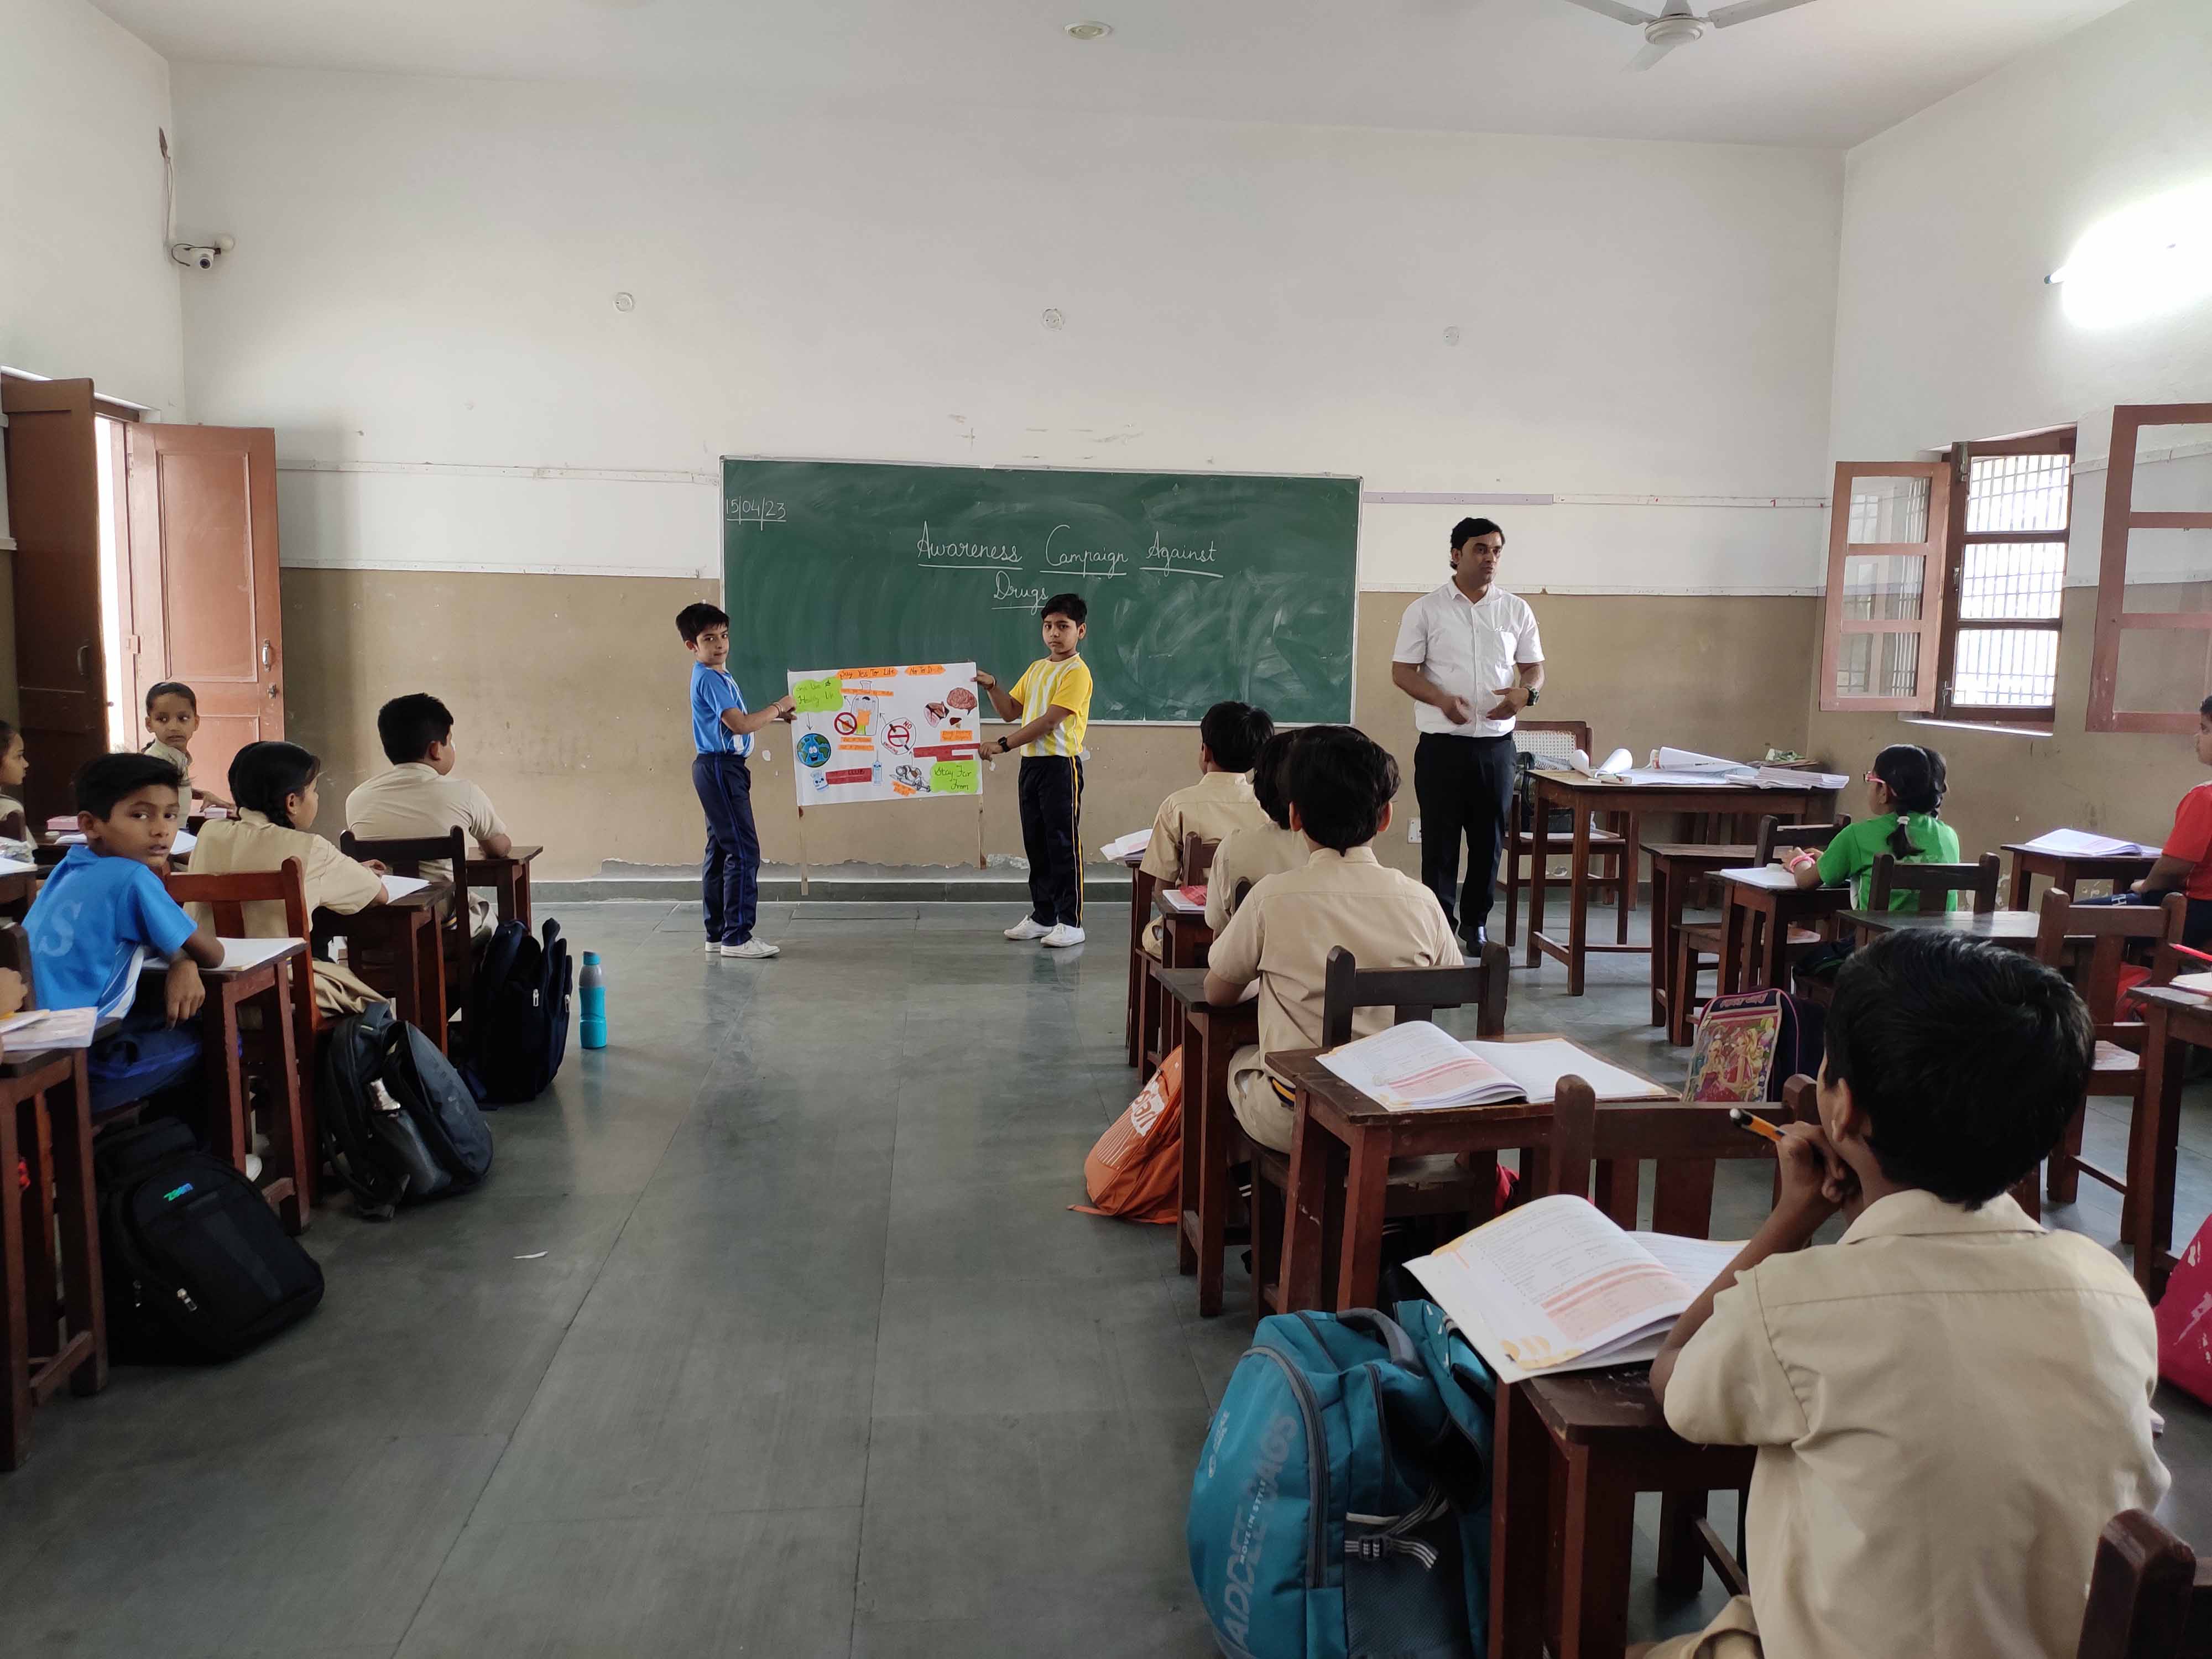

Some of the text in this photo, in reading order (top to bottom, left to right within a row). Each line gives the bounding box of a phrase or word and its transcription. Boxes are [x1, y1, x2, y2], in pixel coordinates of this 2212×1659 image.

[917, 520, 1218, 578] Awareness Campaign Against
[994, 570, 1048, 615] Drugs
[839, 671, 853, 680] Say
[858, 669, 868, 677] Yes
[902, 721, 912, 729] NO
[934, 765, 972, 781] Stay Far
[1240, 1478, 1266, 1565] MOVE IN STYLE
